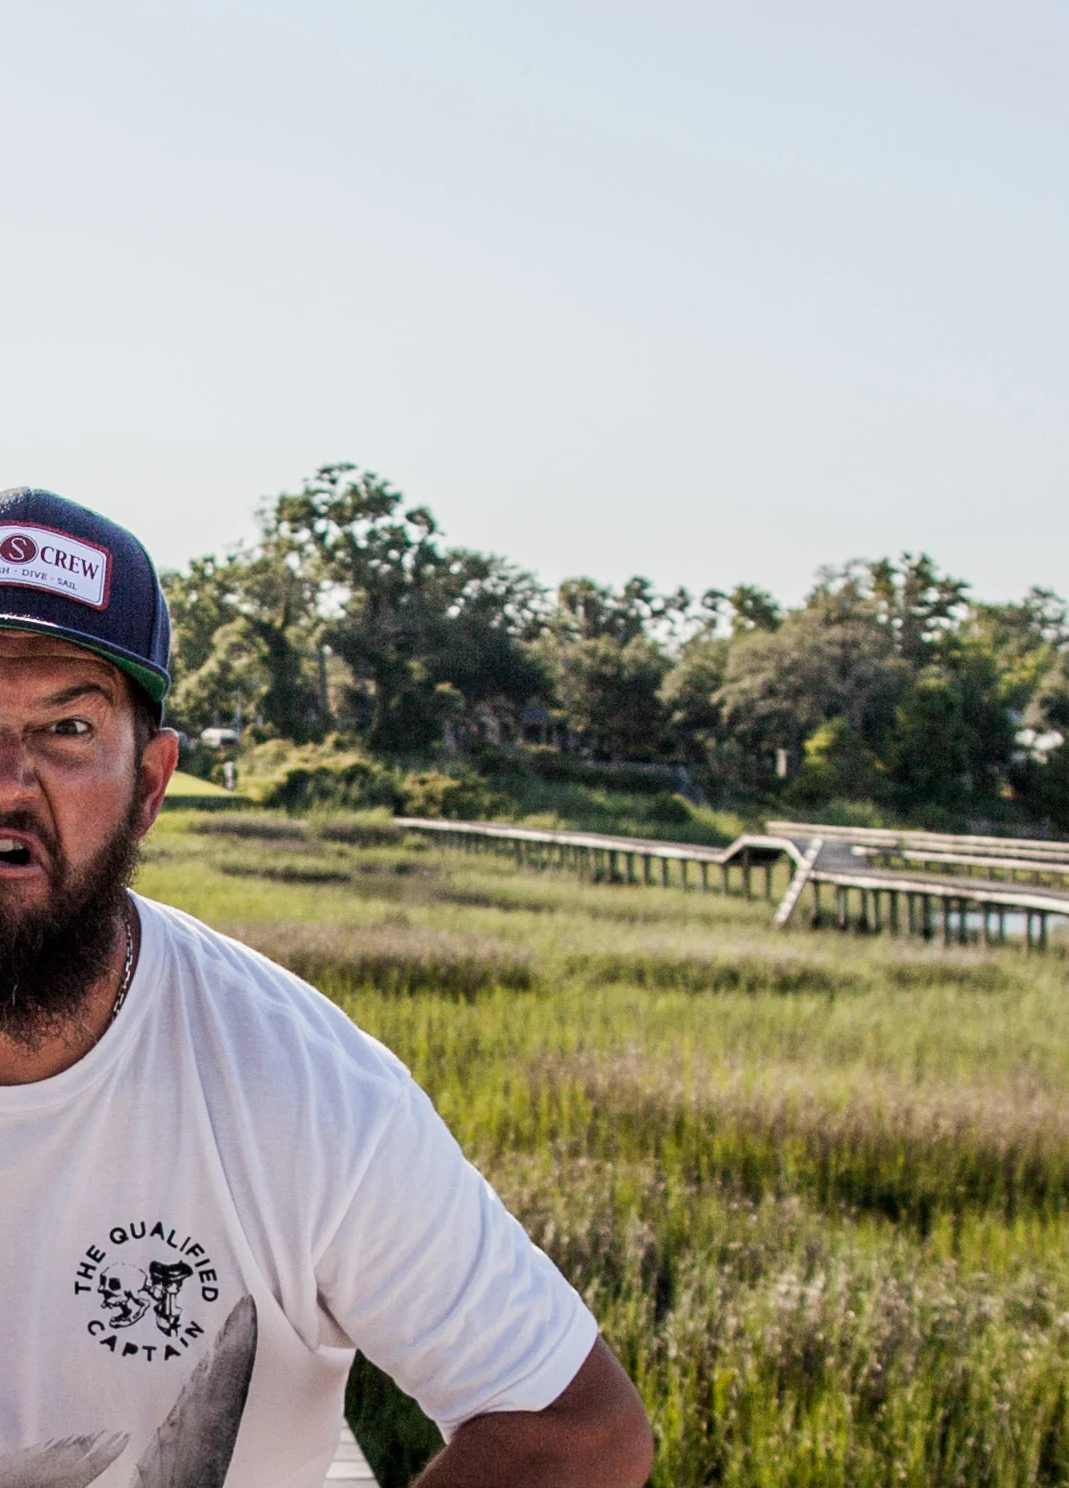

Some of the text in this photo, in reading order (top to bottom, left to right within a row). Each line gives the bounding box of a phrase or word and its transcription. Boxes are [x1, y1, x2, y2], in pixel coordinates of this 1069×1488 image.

[21, 568, 47, 581] DIVE
[57, 577, 78, 591] SAIL
[40, 545, 100, 580] CREW
[74, 1221, 219, 1303] THE QUALIFIED
[87, 1319, 205, 1362] CAPTAIN
